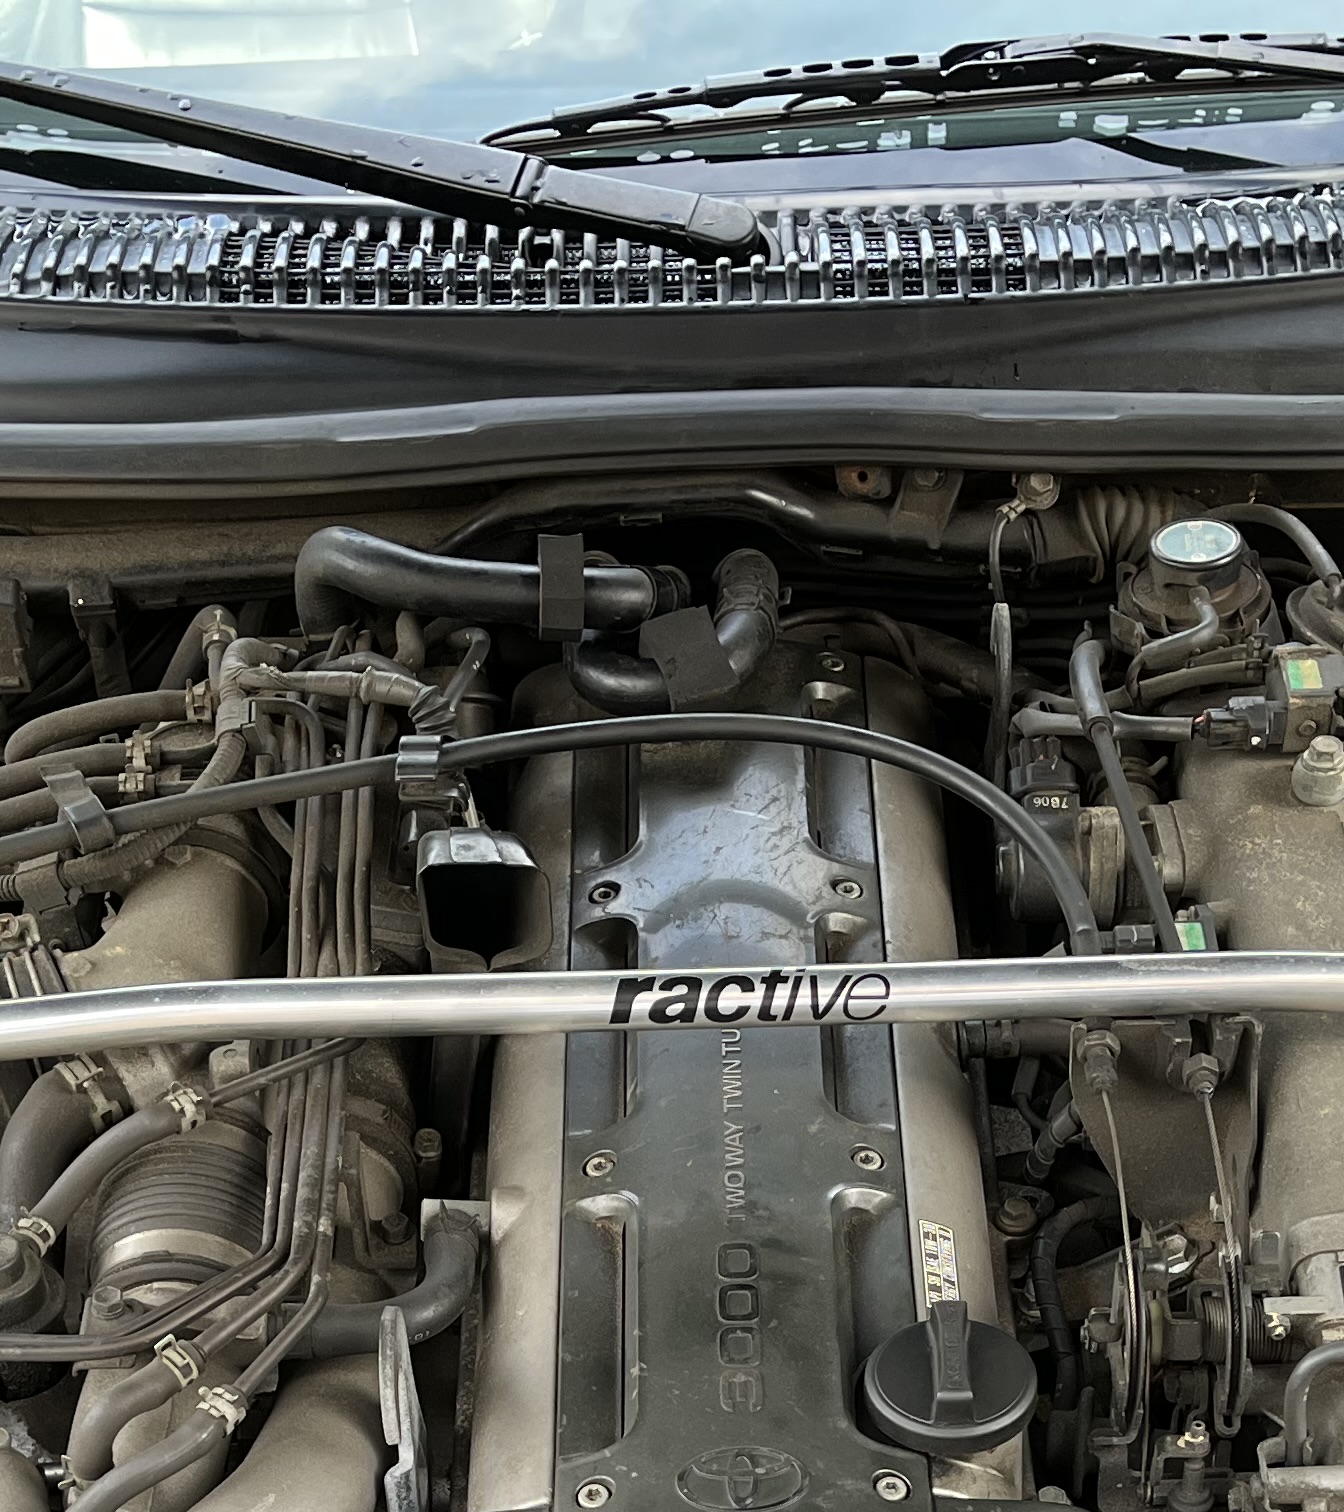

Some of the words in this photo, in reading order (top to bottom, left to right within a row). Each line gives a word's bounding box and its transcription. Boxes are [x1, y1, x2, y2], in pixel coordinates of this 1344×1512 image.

[609, 968, 891, 1024] ractive
[722, 1059, 744, 1113] TWIN
[723, 1121, 745, 1167] WAY
